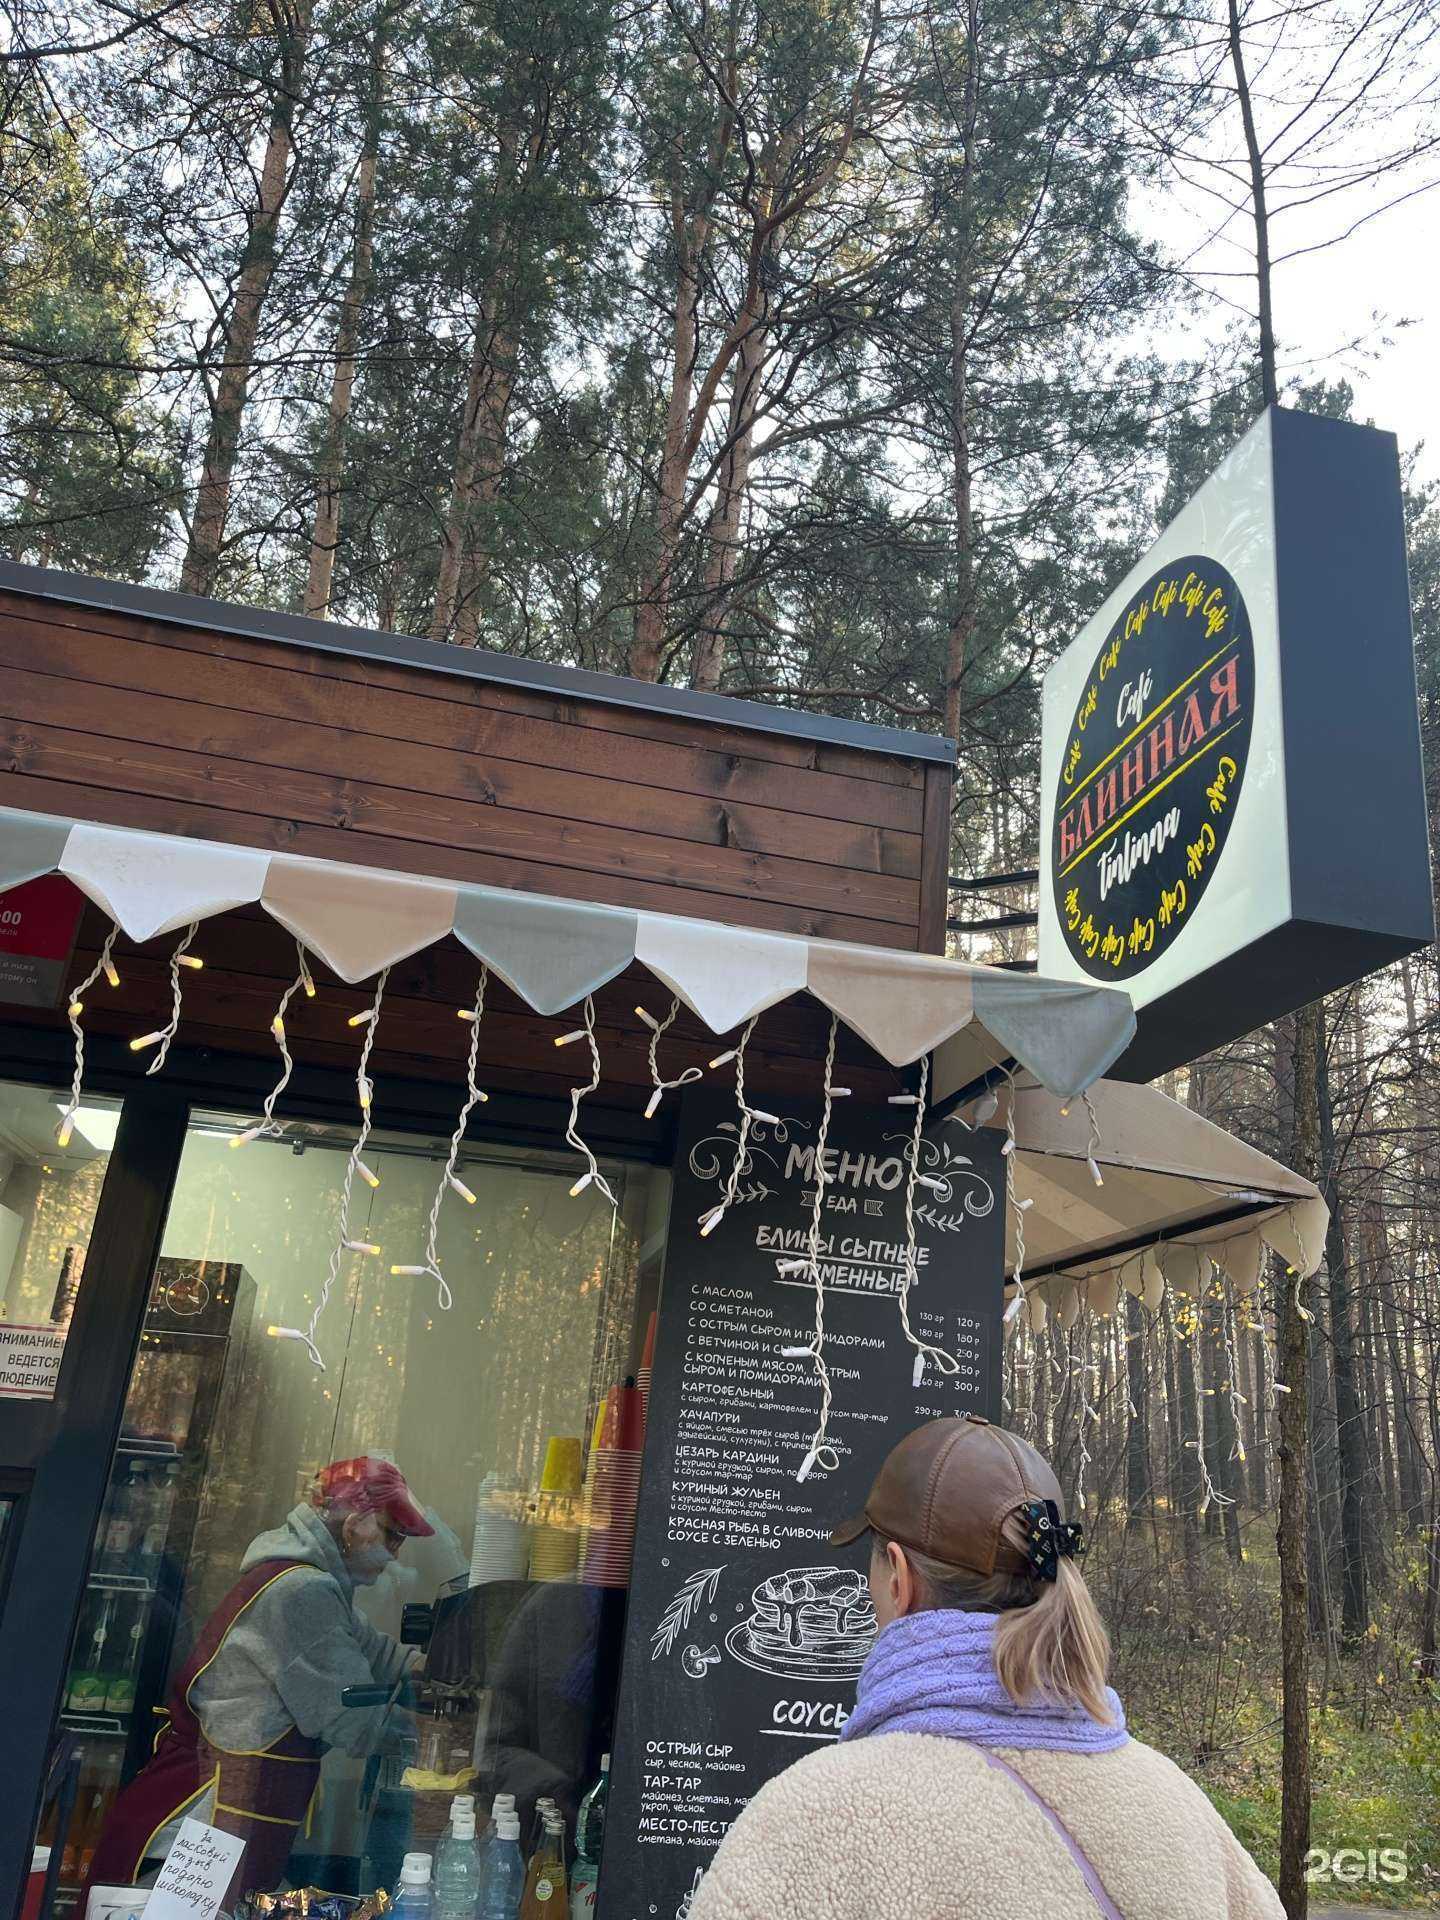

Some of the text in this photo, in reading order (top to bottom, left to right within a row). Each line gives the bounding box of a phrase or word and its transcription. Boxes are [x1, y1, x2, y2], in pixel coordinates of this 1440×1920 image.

[1117, 669, 1153, 728] Café
[1059, 654, 1241, 865] БЛИННАЯ
[784, 1144, 903, 1190] МЕНЮ
[826, 1196, 857, 1213] ЕДА
[756, 1225, 930, 1266] БЛИНЫ СЫТНЫЕ
[692, 1285, 753, 1300] С МАСЛОМ
[690, 1301, 773, 1318] СО СМЕТАНОЙ
[920, 1312, 933, 1320] 130
[957, 1318, 973, 1327] 120
[688, 1317, 885, 1349] С ОСТРЫМ СЫРОМ И ПОМИДОРАМИ
[919, 1329, 932, 1337] 180
[975, 1338, 980, 1346] р
[688, 1335, 695, 1344] С
[698, 1336, 759, 1351] ВЕТЧИНОЙ
[763, 1343, 769, 1352] И
[8, 1354, 60, 1369] ВЕДЕТСЯ
[685, 1352, 692, 1361] С
[696, 1352, 758, 1368] КОПЧЕНЫМ
[762, 1360, 806, 1375] МЯСОМ,
[956, 1349, 979, 1361] 250 р
[0, 1372, 56, 1387] ЛЮДЕНИЕ
[684, 1364, 822, 1387] СЫРОМ И ПОМИДОРАМИ
[975, 1370, 980, 1378] р
[682, 1381, 774, 1400] КАРТОФЕЛЬНЫЙ
[917, 1377, 932, 1386] 60
[954, 1381, 973, 1391] 300
[975, 1386, 980, 1394] р
[679, 1409, 740, 1424] ХАЧАПУРИ
[688, 1395, 717, 1405] сыром,
[719, 1396, 757, 1409] грибами,
[759, 1402, 811, 1415] картофелем
[851, 1411, 889, 1423] тар-тар
[915, 1406, 930, 1415] 290
[686, 1421, 714, 1432] яйцом,
[716, 1425, 748, 1435] смесью
[775, 1431, 799, 1440] сыров
[677, 1431, 728, 1443] адыгейский,
[731, 1436, 772, 1448] сулугуни),
[675, 1444, 779, 1464] ЦЕЗАРЬ КАРДИНИ
[681, 1468, 712, 1478] соусом
[714, 1471, 753, 1482] тар-тар
[682, 1459, 716, 1469] куриной
[717, 1462, 754, 1473] грудкой,
[756, 1466, 785, 1477] сыром,
[787, 1469, 828, 1480] подоро
[672, 1481, 780, 1500] КУРИНЫЙ ЖУЛЬЕН
[678, 1495, 710, 1504] куриной
[712, 1498, 745, 1508] грудкой,
[748, 1500, 783, 1512] грибами,
[786, 1505, 812, 1514] сыром
[678, 1504, 706, 1513] соусом
[709, 1505, 766, 1518] Место-песто
[668, 1517, 725, 1530] КРАСНАЯ
[728, 1521, 759, 1533] РЫБА
[763, 1525, 770, 1534] В
[667, 1530, 780, 1549] СОУСЕ С ЗЕЛЕНЬЮ
[646, 1741, 733, 1757] ОСТРЫЙ СЫР
[645, 1758, 746, 1772] сыр, чеснок, майонез
[644, 1775, 702, 1789] ТАР-ТАР
[641, 1791, 682, 1803] майонез,
[686, 1794, 732, 1805] сметана,
[641, 1802, 705, 1814] укроп, чеснок
[201, 1829, 212, 1843] За
[637, 1835, 723, 1847] сметана, майоне
[163, 1864, 214, 1889] подарю
